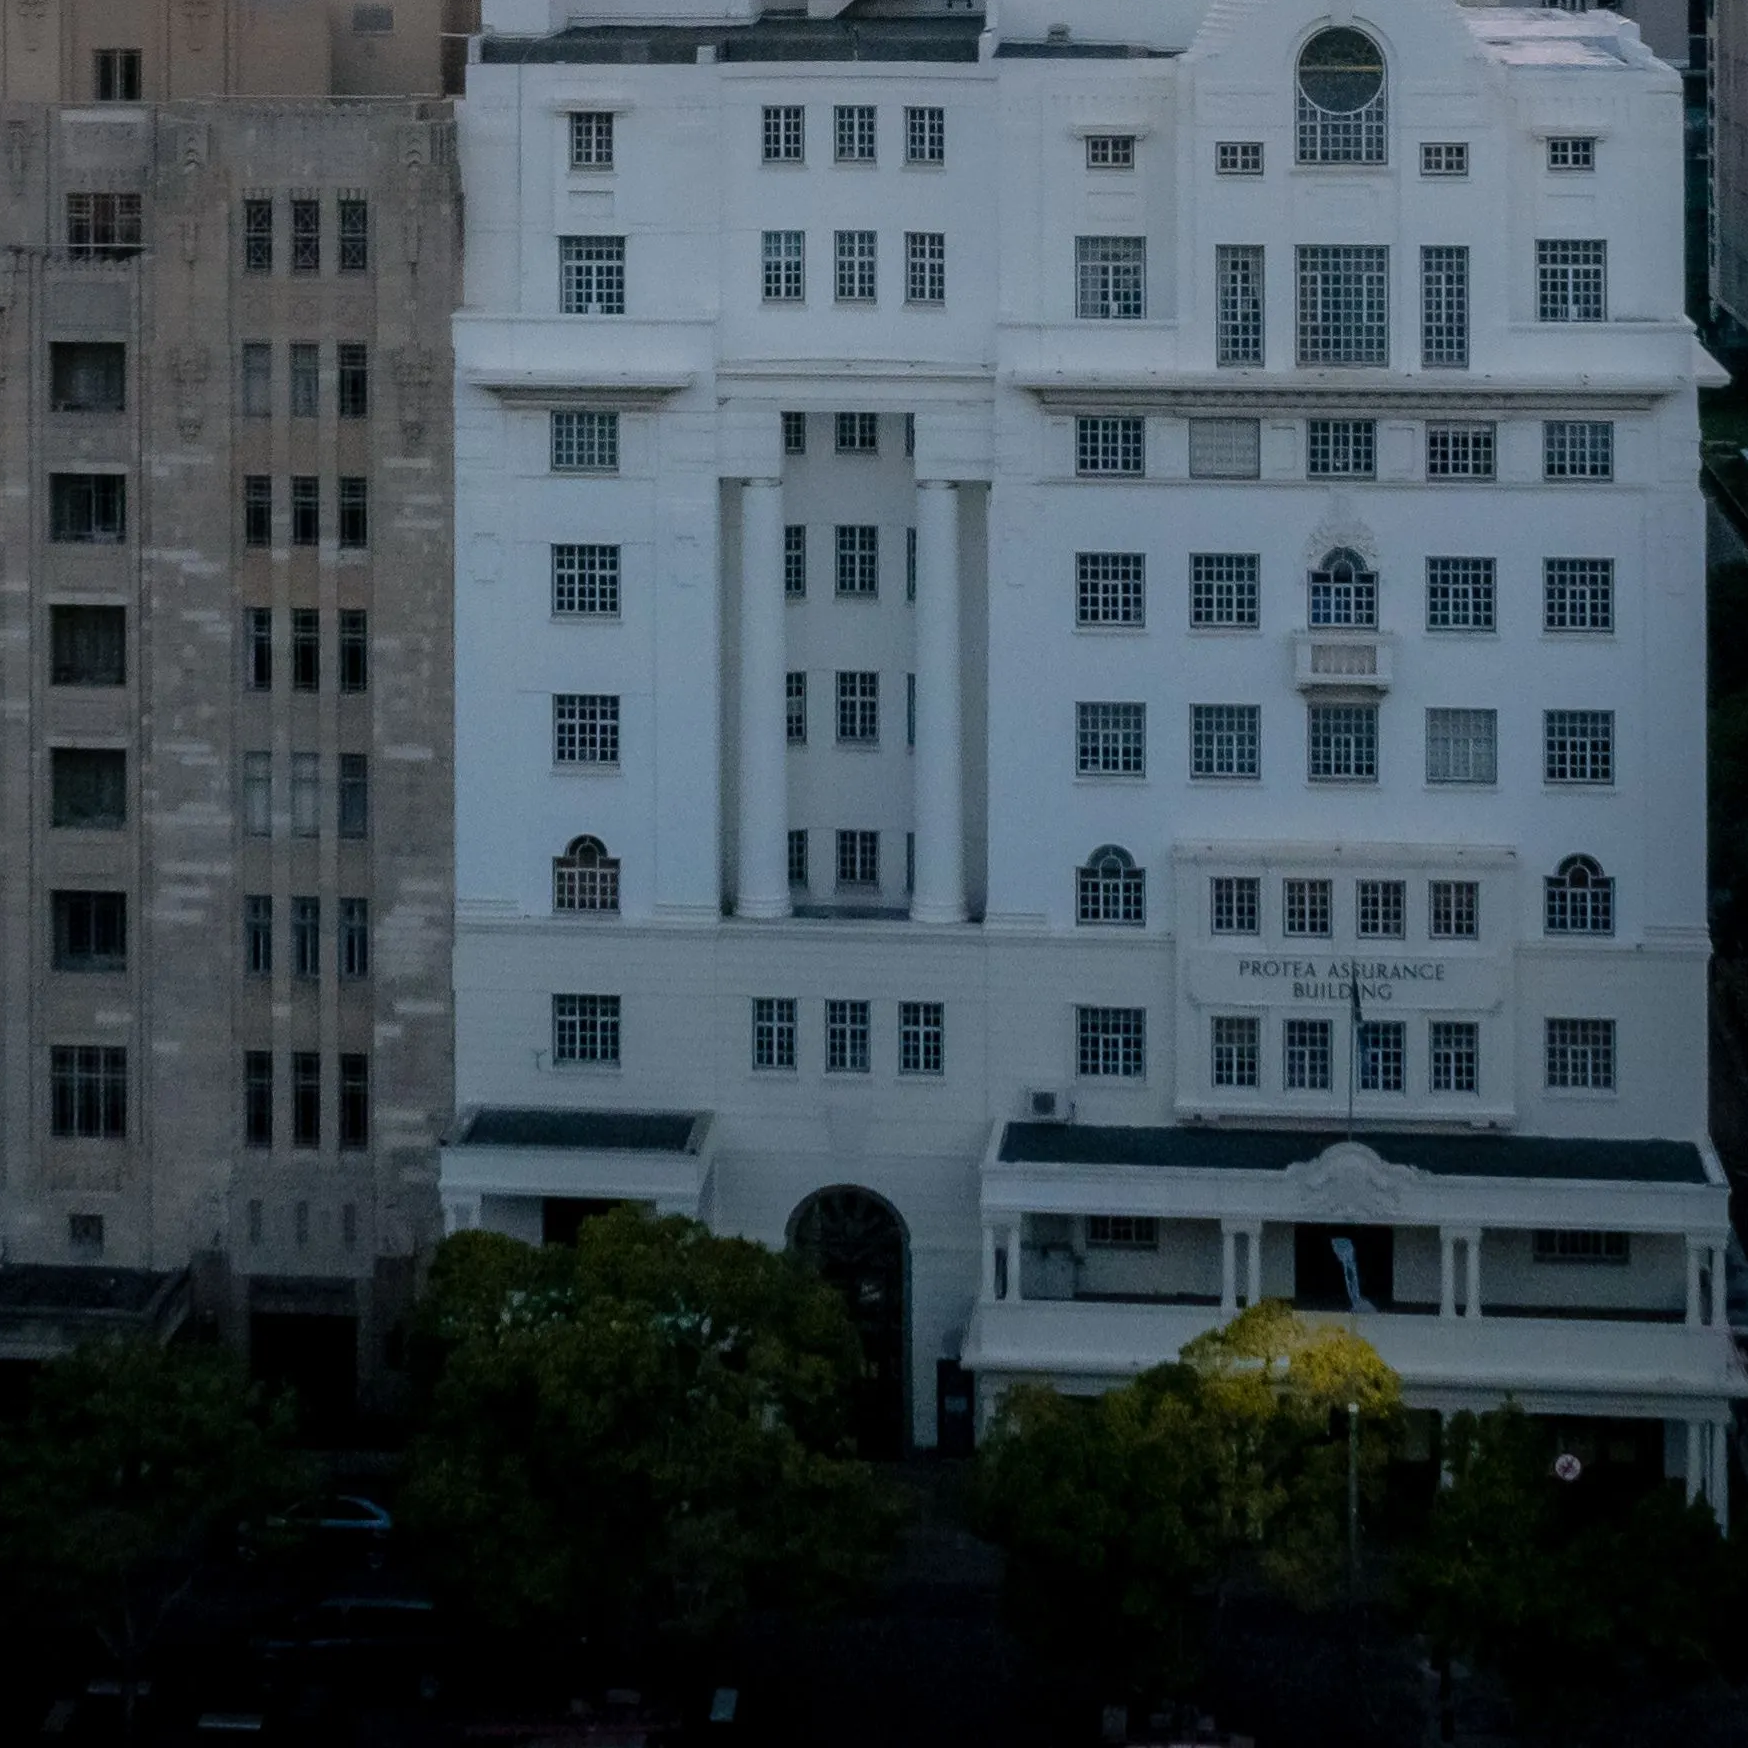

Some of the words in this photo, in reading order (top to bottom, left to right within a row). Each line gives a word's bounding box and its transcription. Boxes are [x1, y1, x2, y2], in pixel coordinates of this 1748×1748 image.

[1238, 960, 1316, 976] PROTEA
[1327, 962, 1445, 981] ASSURANCE
[1292, 982, 1392, 1000] BUILDNG
